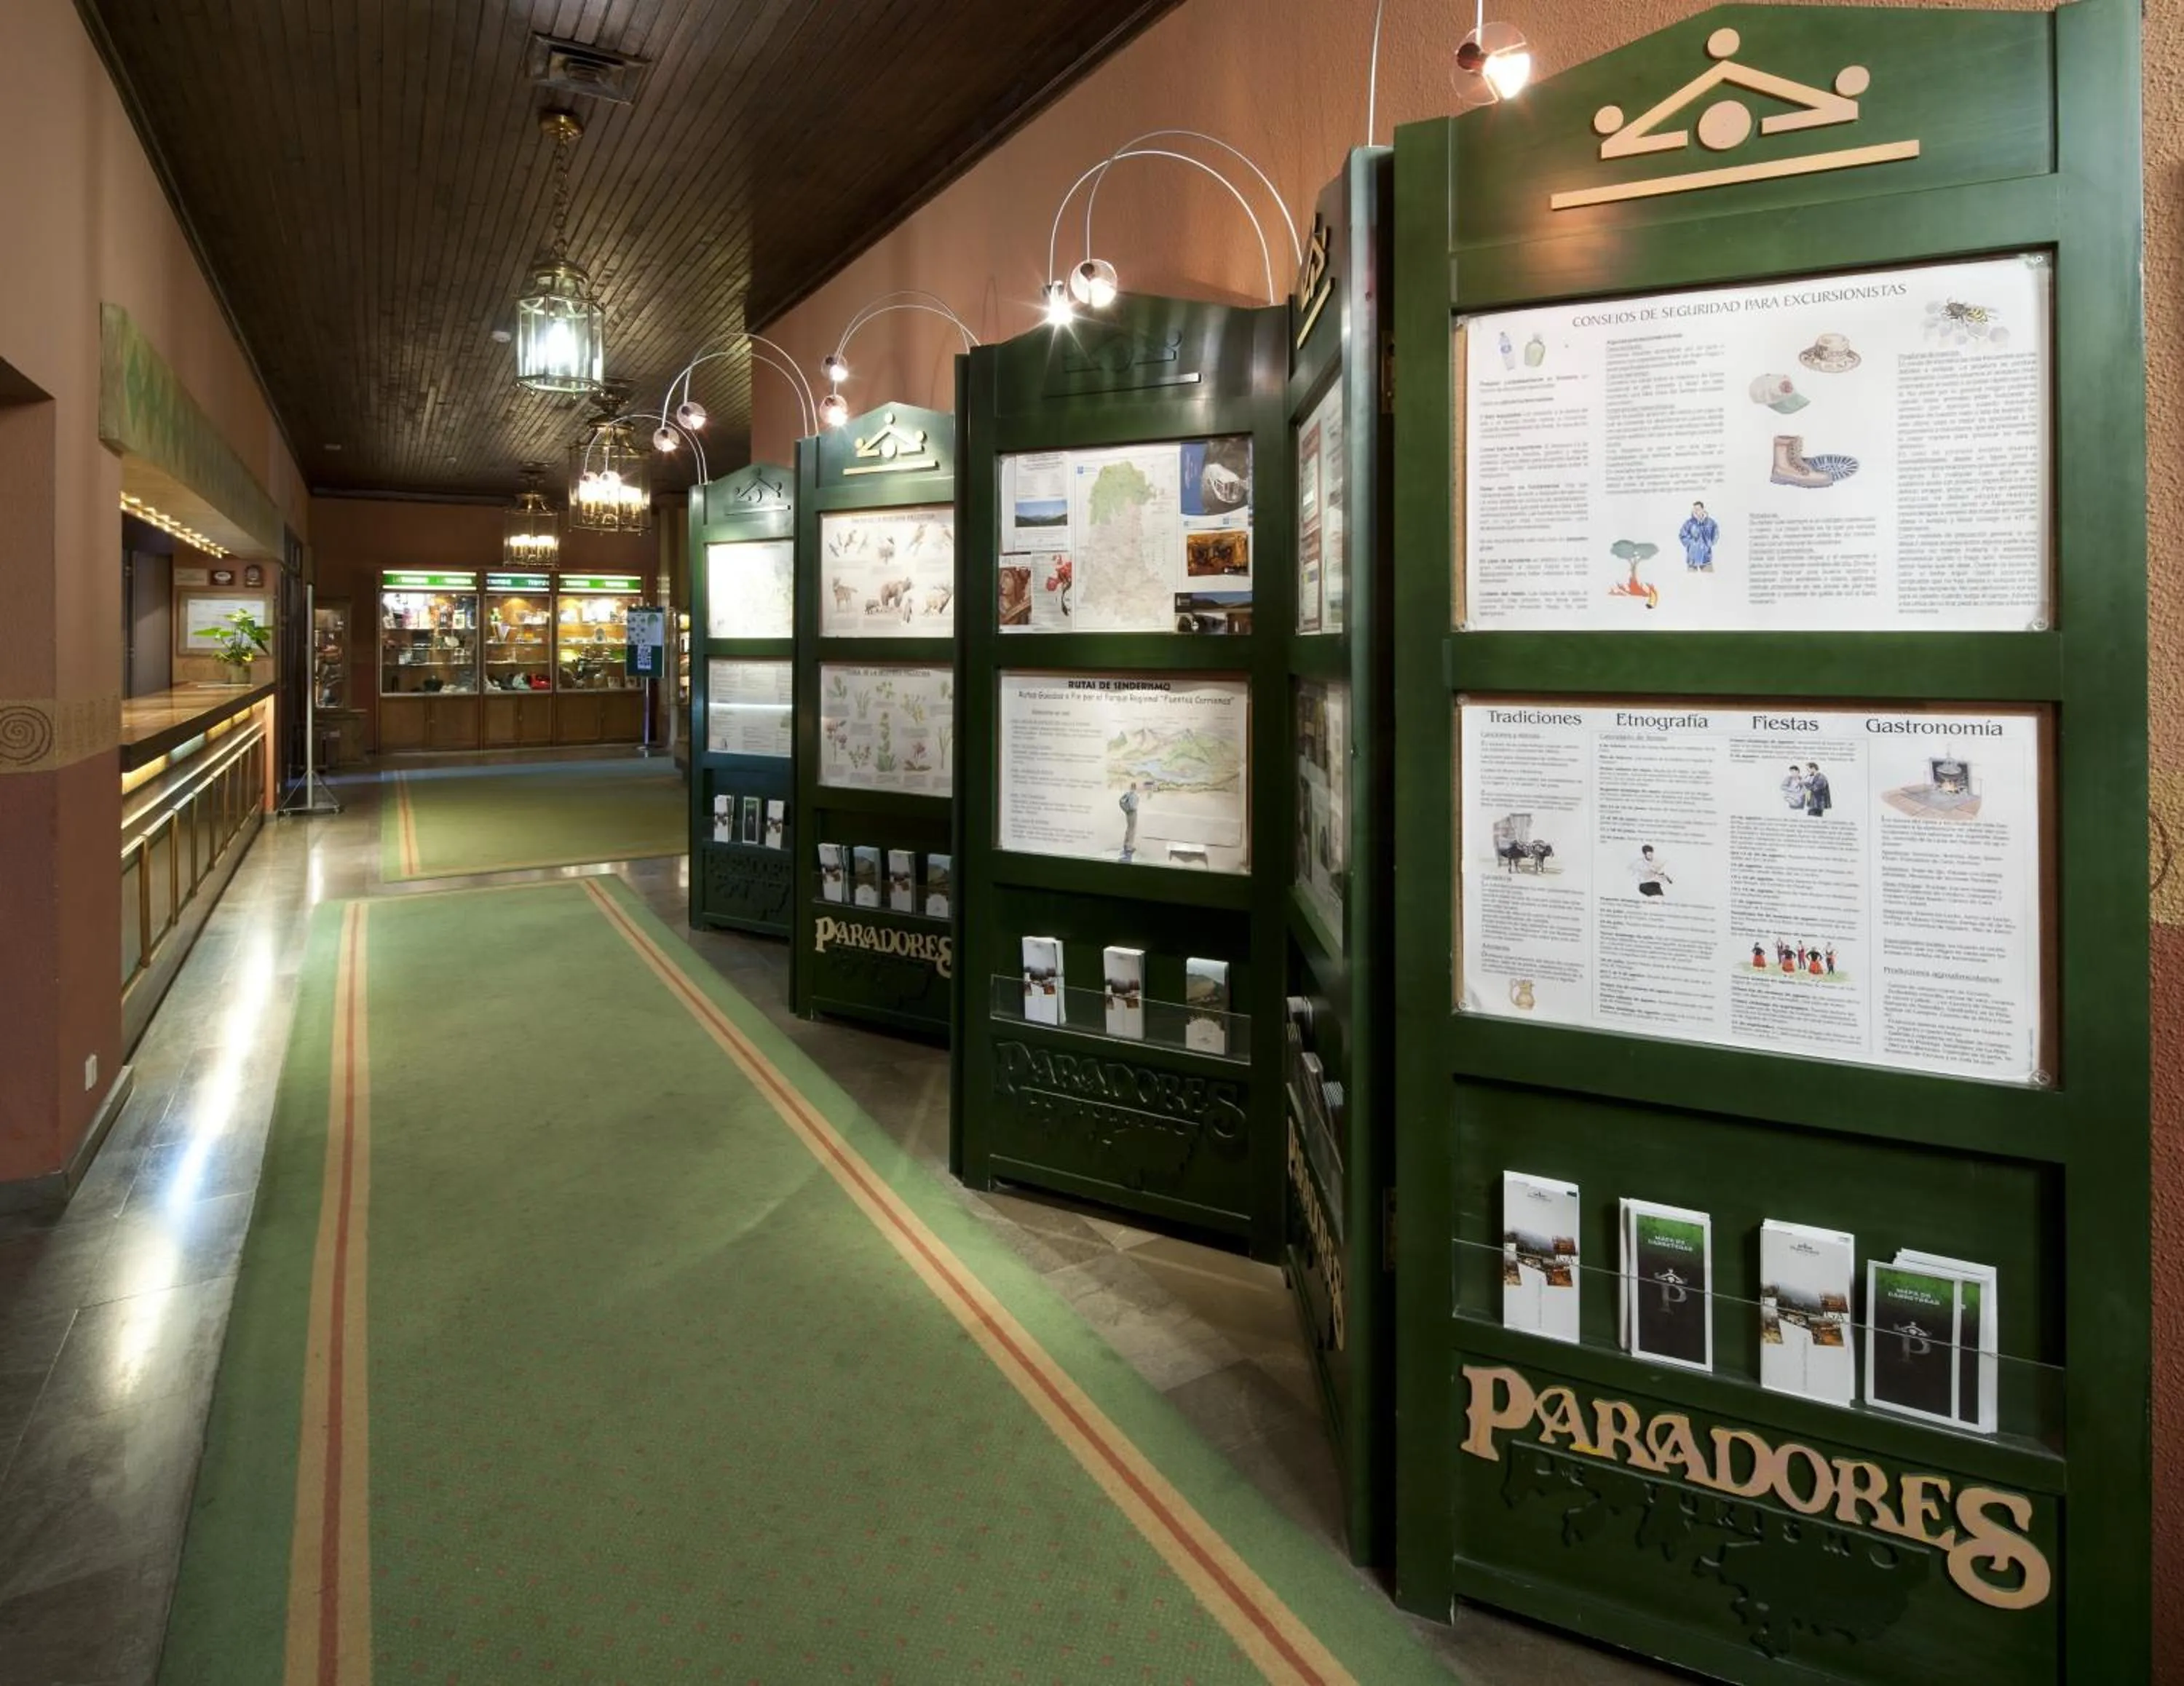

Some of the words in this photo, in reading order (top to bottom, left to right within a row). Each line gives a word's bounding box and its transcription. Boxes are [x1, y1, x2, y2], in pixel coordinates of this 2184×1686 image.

[1572, 312, 1637, 328] CONSEJOS
[1640, 307, 1659, 321] DE
[1662, 300, 1741, 318] SEGURIDAD
[1745, 296, 1780, 311] PARA
[1784, 282, 1907, 307] EXCURSIONISTAS
[1068, 680, 1096, 689] RUTAS
[1099, 681, 1110, 689] DE
[1115, 681, 1171, 691] SENDERISMO
[1486, 710, 1583, 726] Tradiciones
[1615, 712, 1709, 731] Etnografía
[1751, 715, 1819, 732] Fiestas
[1865, 718, 2003, 737] Gastronomía
[1460, 1364, 2052, 1610] PARADORES
